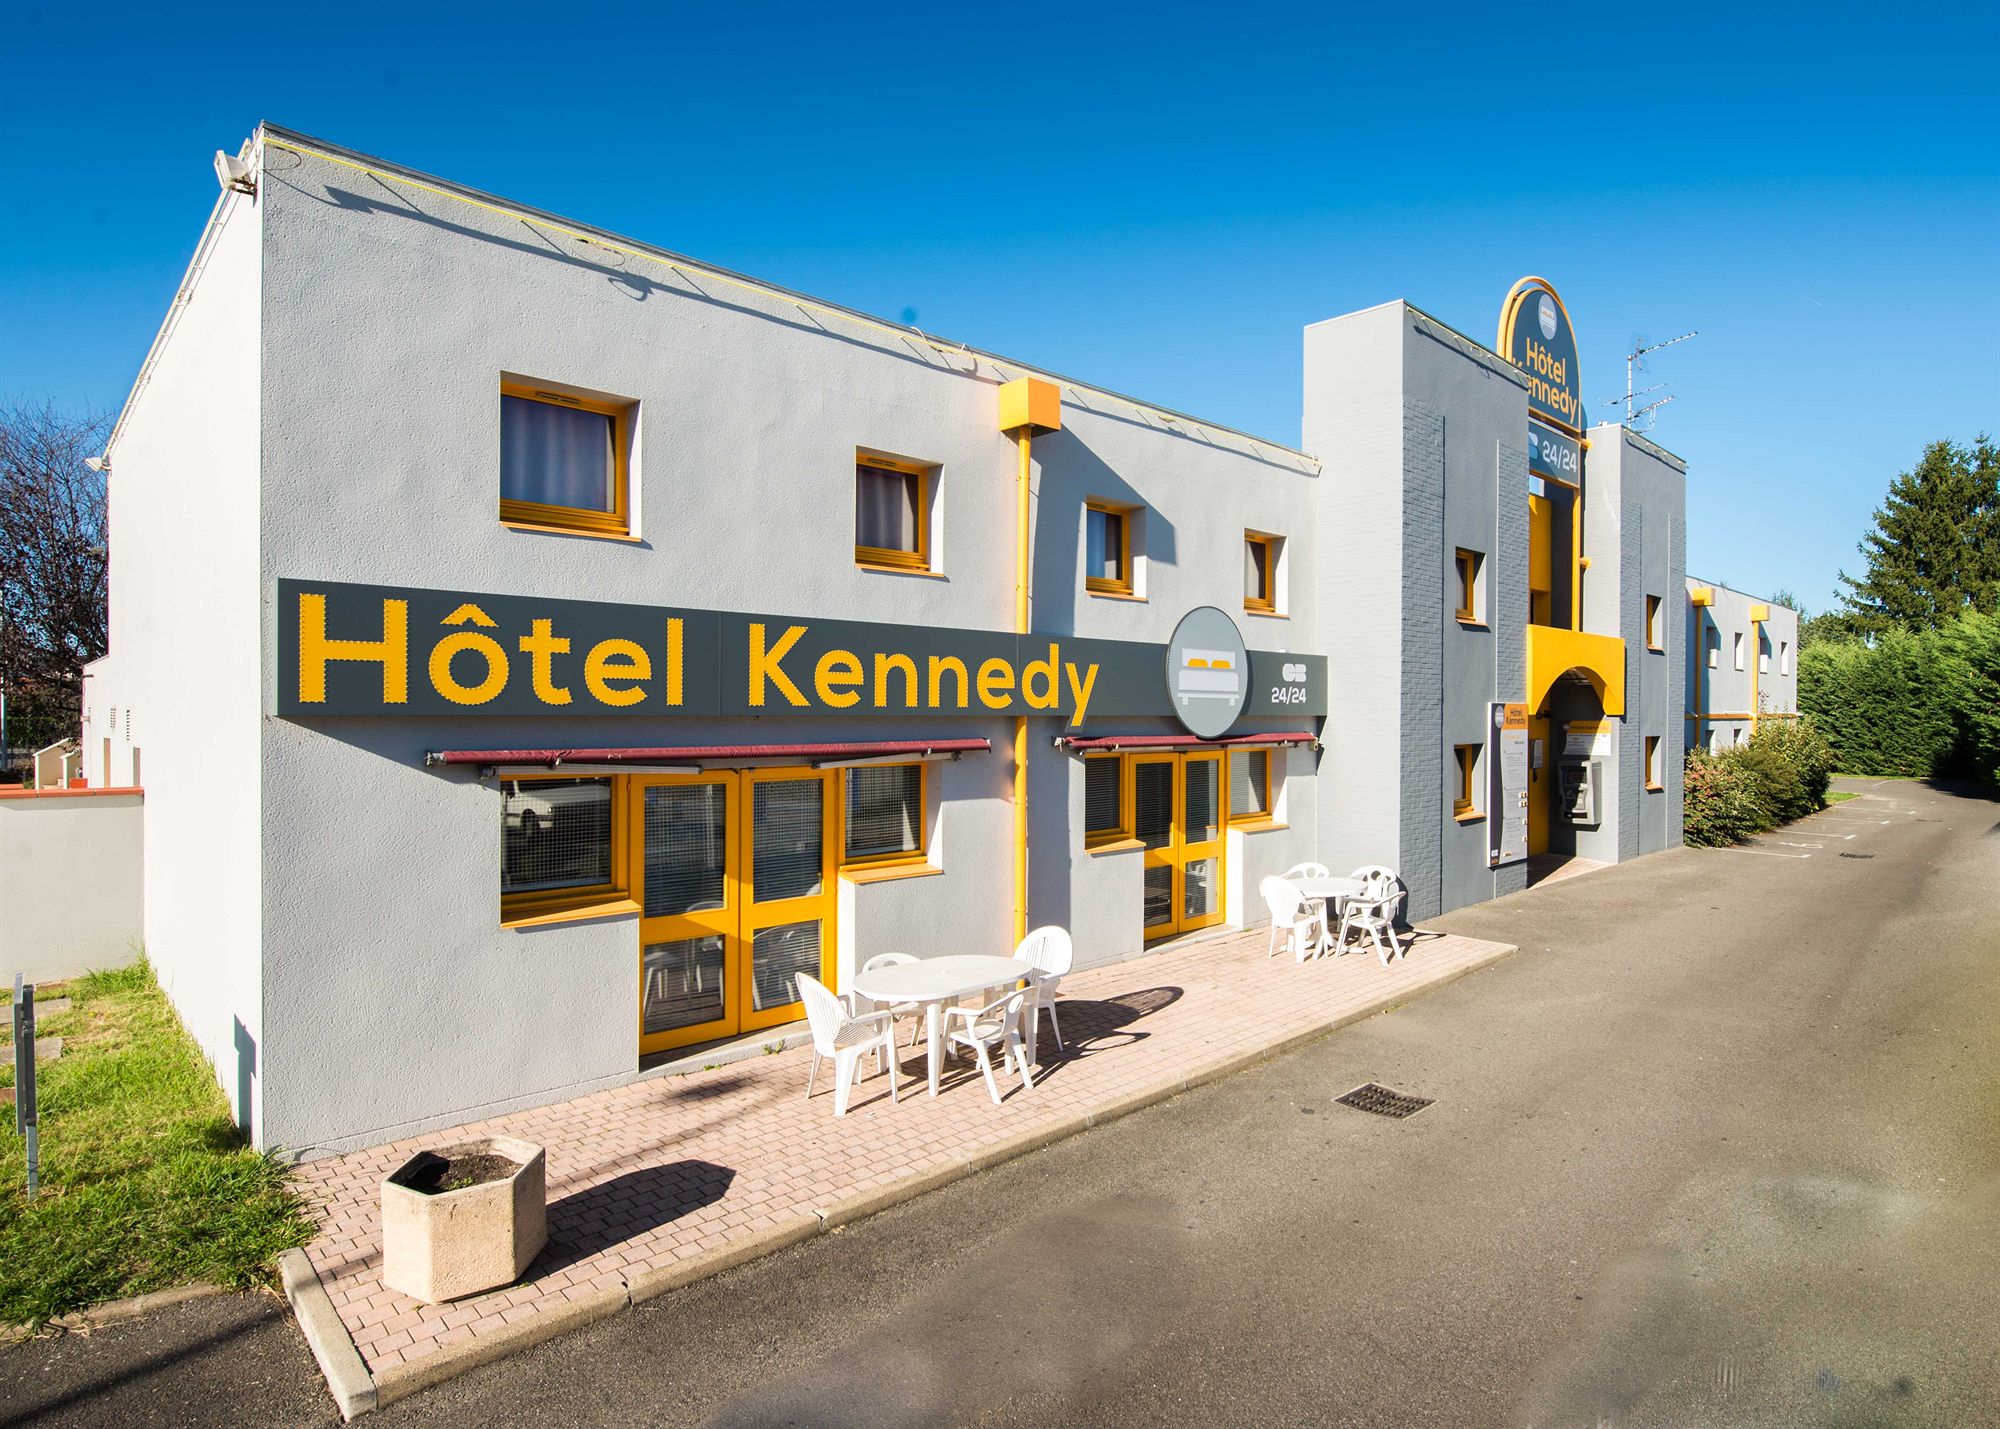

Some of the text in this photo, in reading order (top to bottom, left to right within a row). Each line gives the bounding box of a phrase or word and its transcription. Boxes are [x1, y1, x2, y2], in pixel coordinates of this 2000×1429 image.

[1526, 337, 1566, 386] Hôtel
[1542, 440, 1577, 473] 24/24
[299, 593, 1100, 727] Hôtel Kennedy
[1271, 686, 1307, 705] 24/24
[1506, 716, 1526, 726] Kennedy
